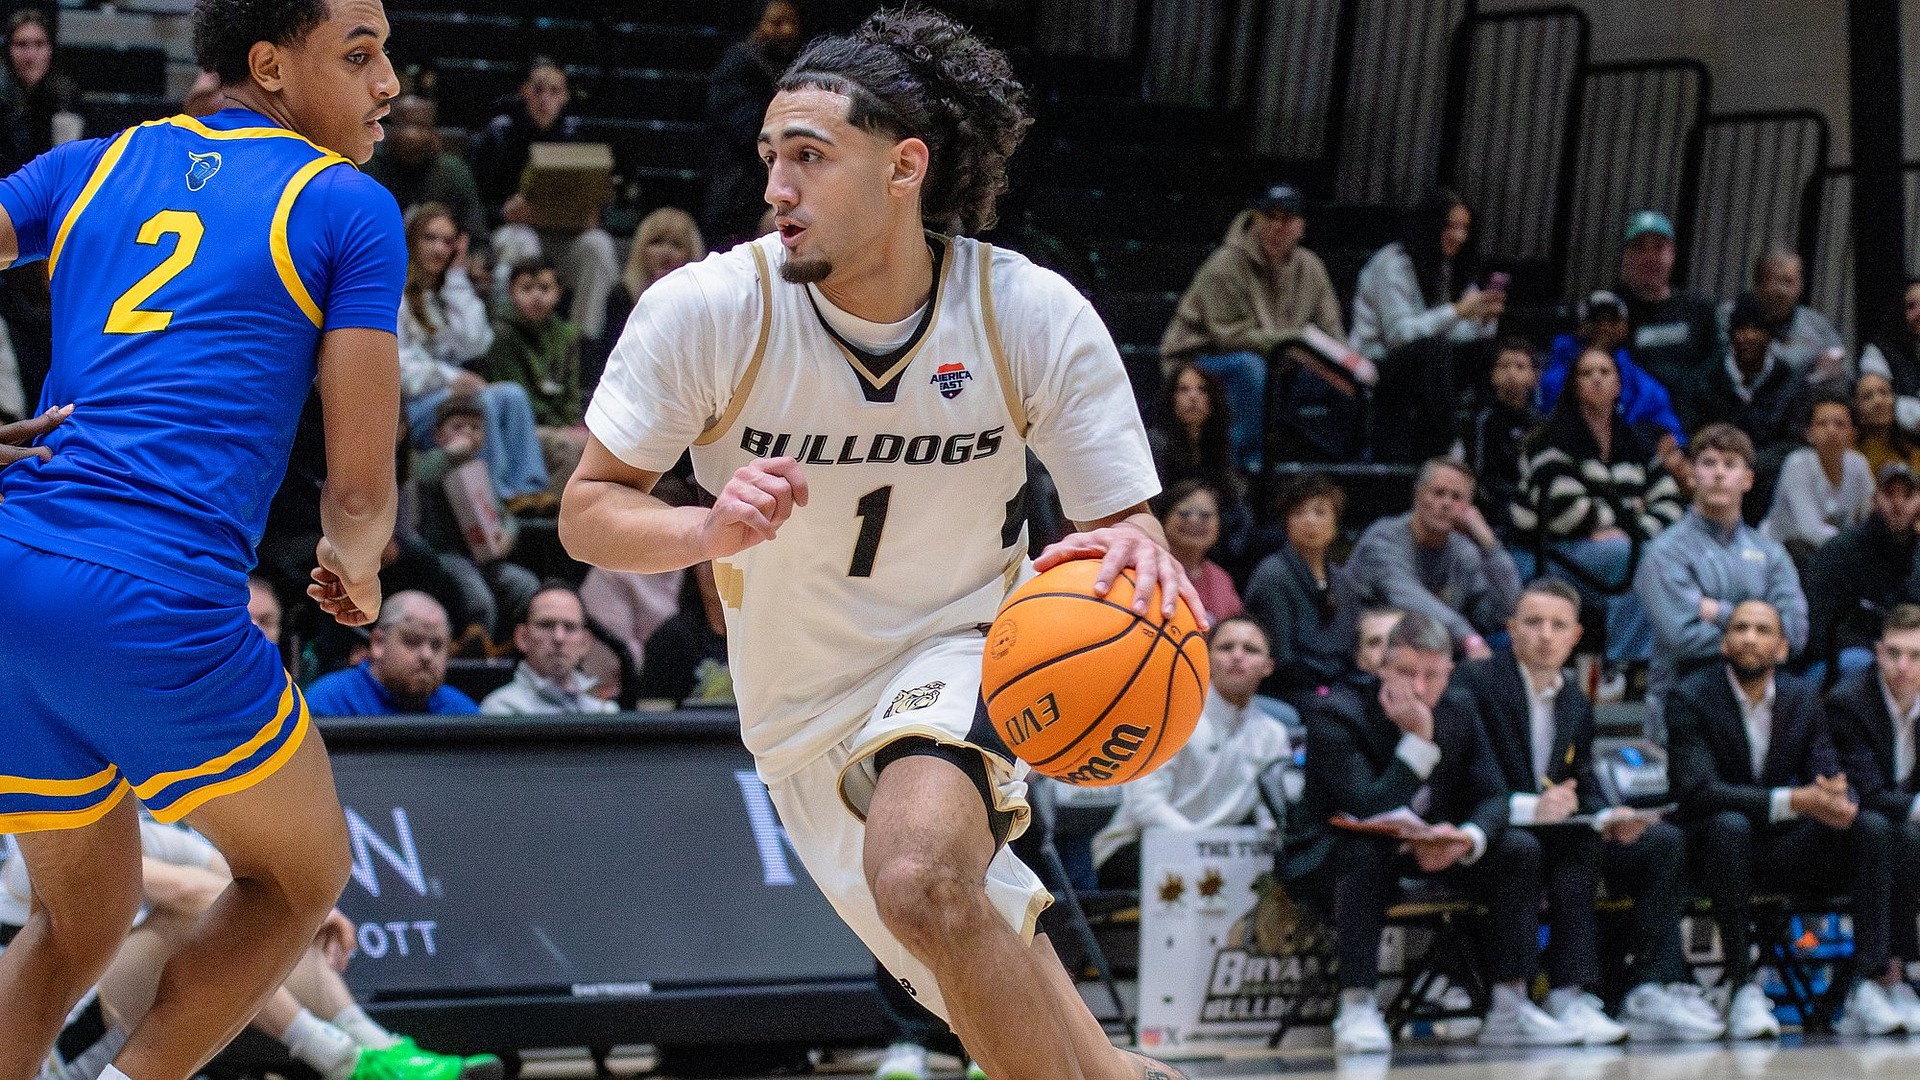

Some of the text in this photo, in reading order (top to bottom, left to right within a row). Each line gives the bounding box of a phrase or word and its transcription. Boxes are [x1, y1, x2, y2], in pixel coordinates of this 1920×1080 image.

[102, 208, 206, 335] 2
[740, 426, 1004, 465] BULLDOGS
[847, 484, 894, 578] 1
